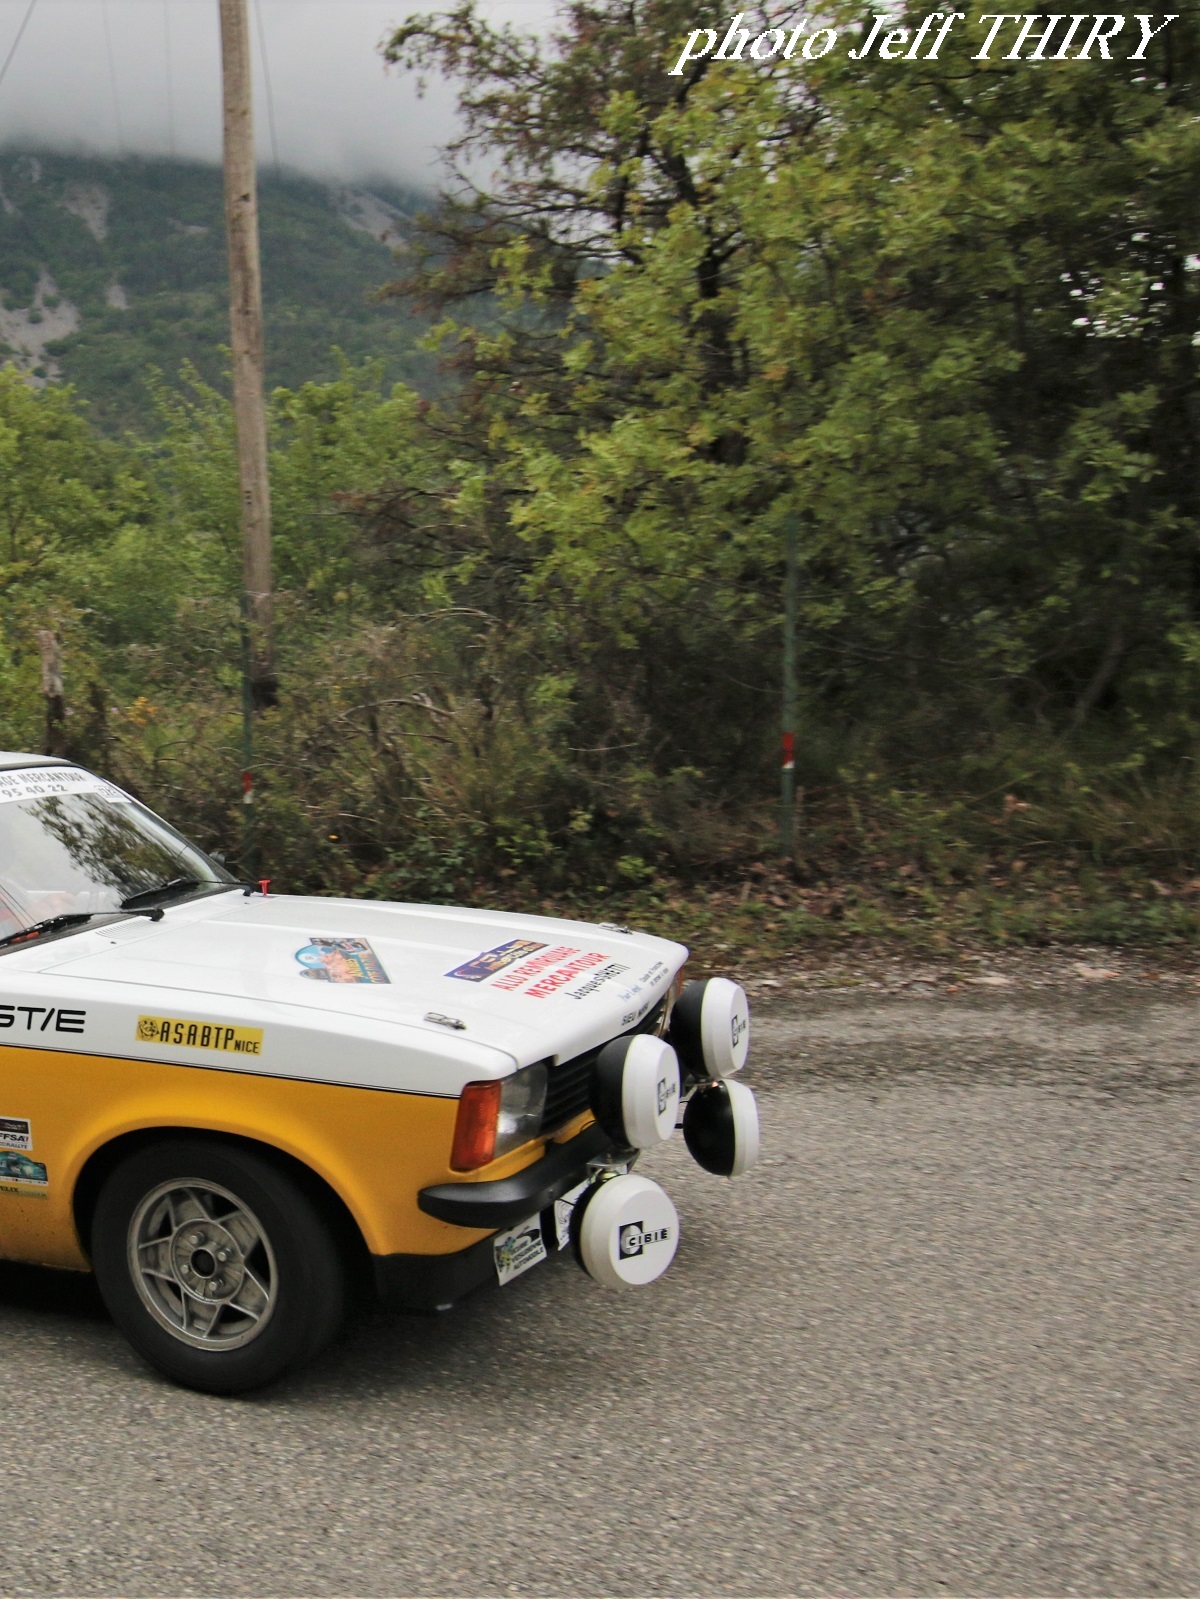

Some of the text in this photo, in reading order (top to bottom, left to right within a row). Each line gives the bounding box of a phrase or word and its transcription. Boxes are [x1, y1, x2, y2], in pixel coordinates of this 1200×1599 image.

[17, 771, 87, 785] MERCANTOUR
[1, 788, 22, 798] 95
[25, 785, 45, 794] 40
[47, 784, 68, 792] 22
[491, 970, 529, 991] ALLO
[234, 1040, 260, 1054] NICE
